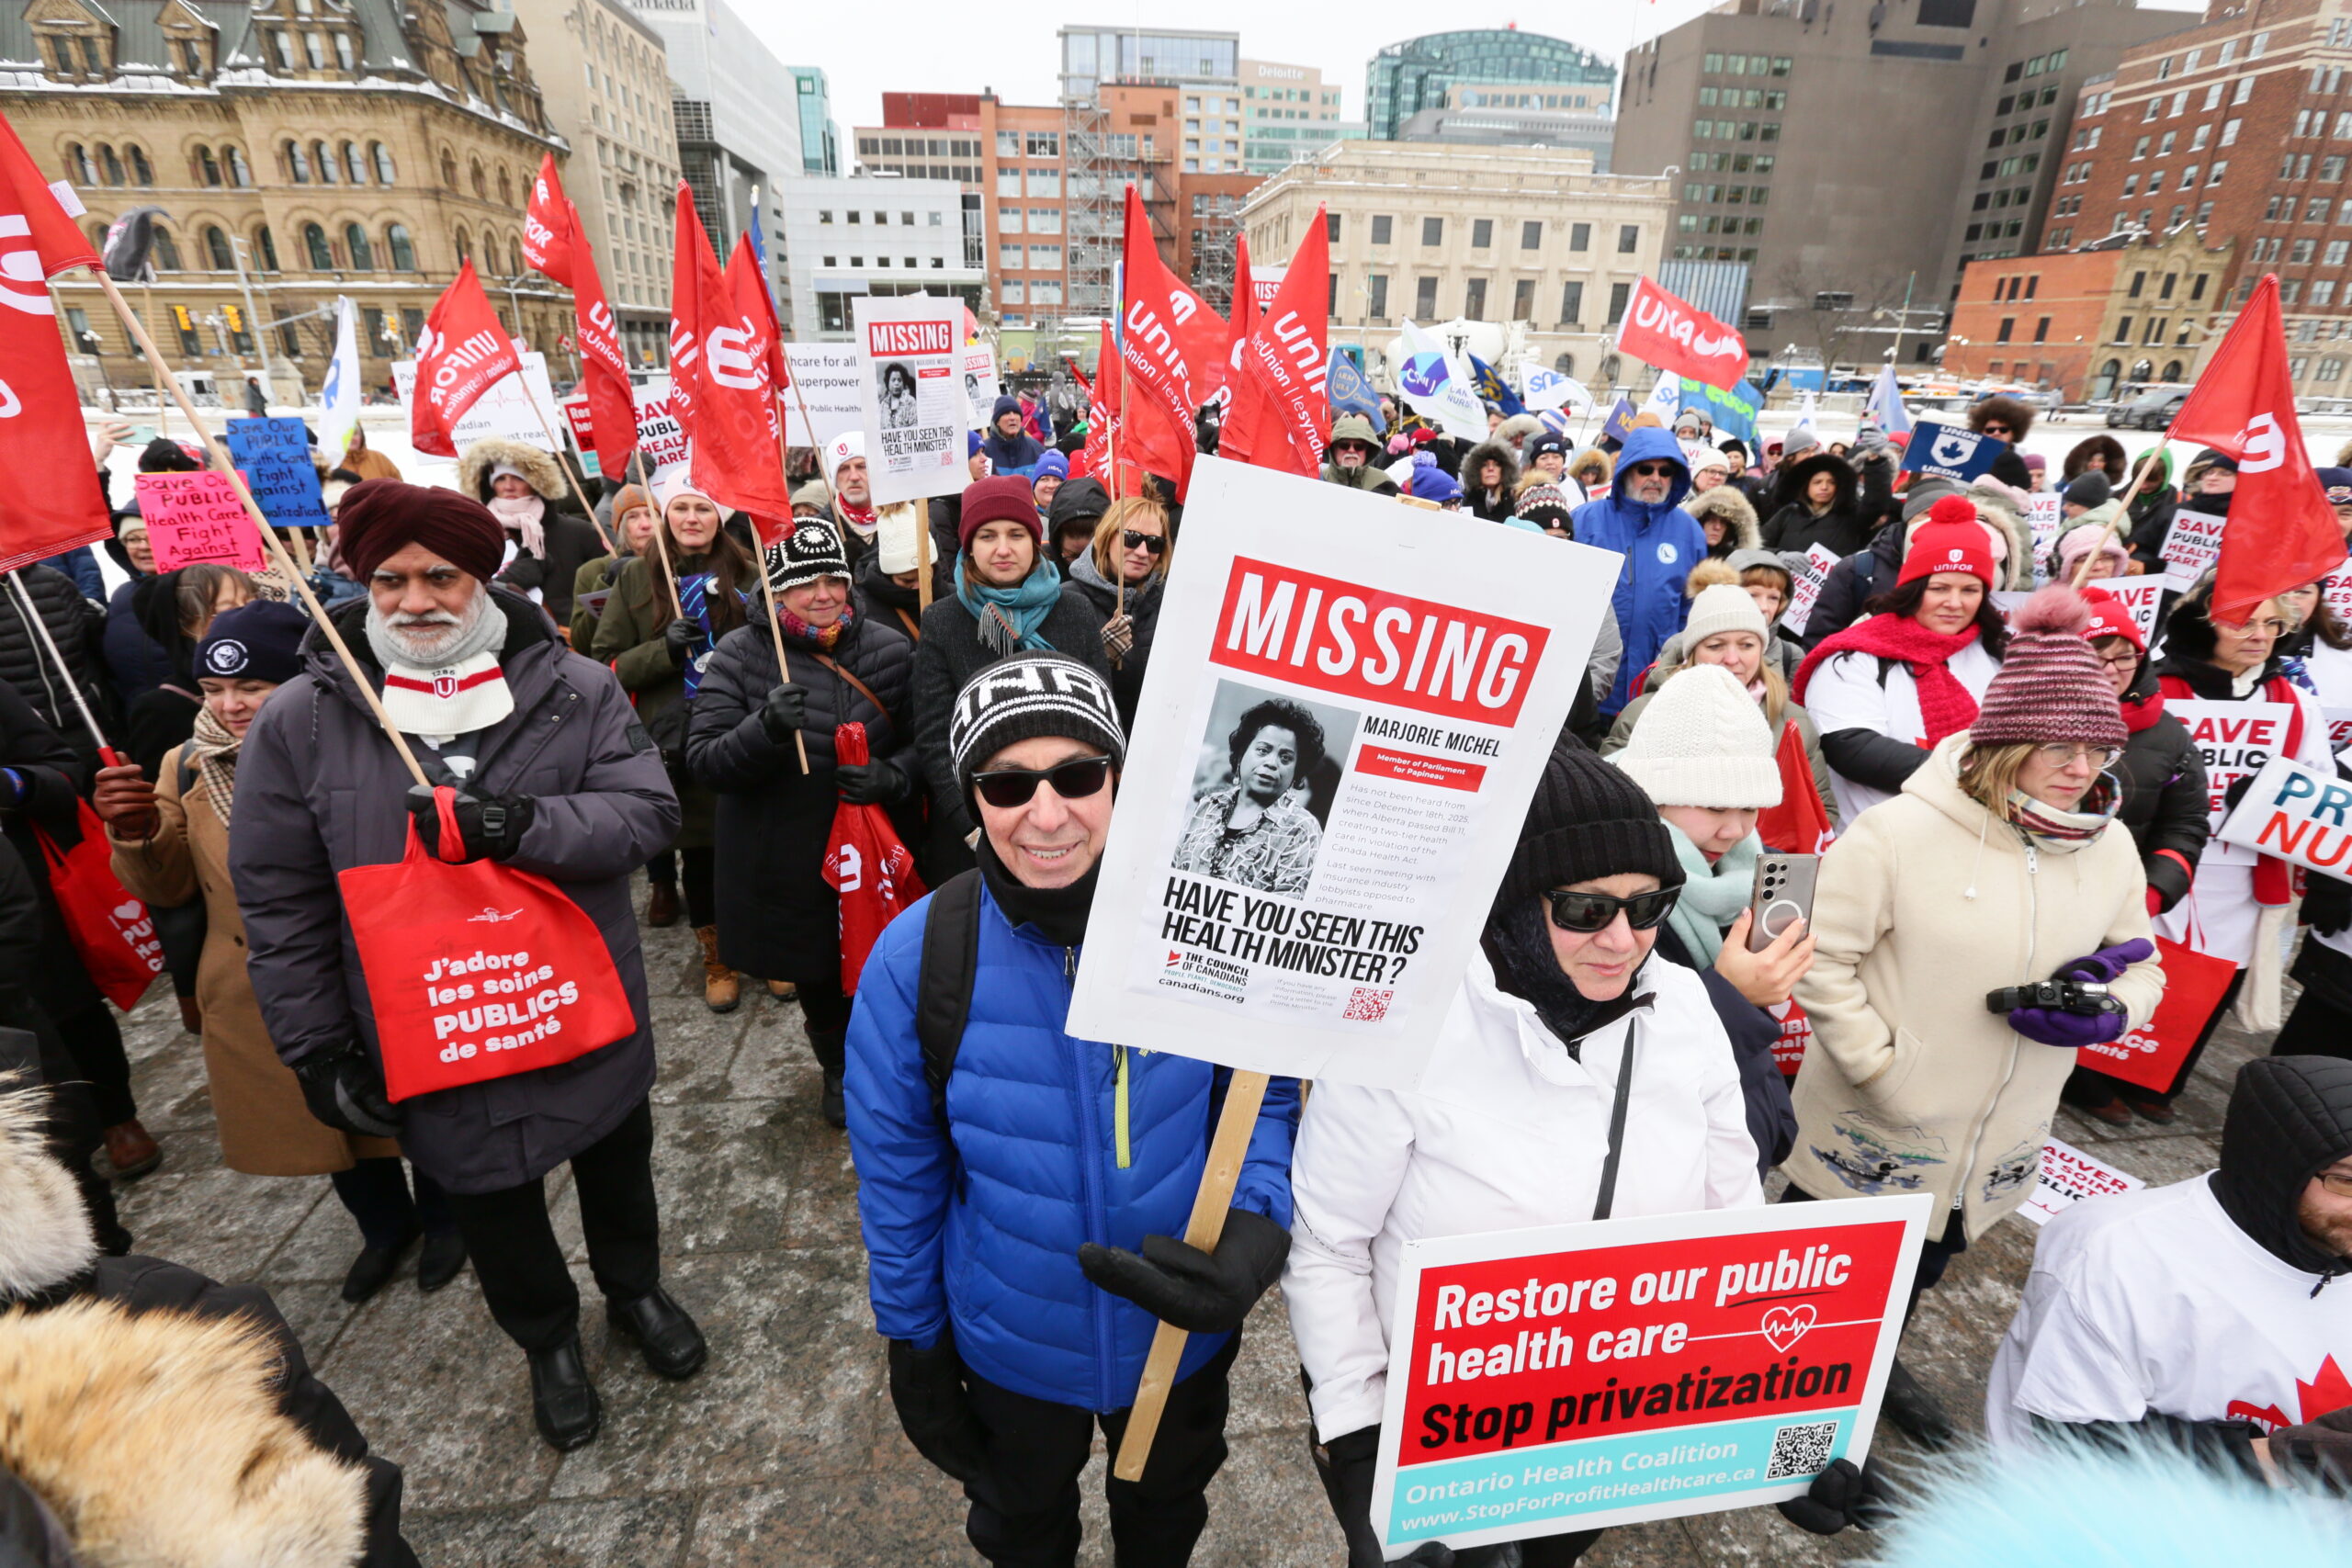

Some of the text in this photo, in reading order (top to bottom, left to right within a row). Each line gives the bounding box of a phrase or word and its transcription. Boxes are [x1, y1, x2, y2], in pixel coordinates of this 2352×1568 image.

[1259, 65, 1304, 80] Deloitte
[872, 323, 950, 353] MISSING
[825, 355, 840, 367] for
[842, 355, 856, 367] all
[634, 398, 672, 423] SAV
[268, 419, 297, 434] Our
[637, 421, 680, 440] PUBL
[882, 426, 954, 445] HAVE YOU SEEN THIS
[1939, 425, 1984, 443] UNDE
[246, 434, 300, 450] PUBLIC
[884, 442, 912, 457] HEALTH
[914, 439, 946, 453] MINISTER
[657, 450, 689, 467] ARE
[136, 474, 195, 491] Save
[257, 467, 295, 486] Fight
[1921, 464, 1963, 479] UEDN
[162, 491, 237, 508] PUBLIC
[251, 479, 307, 502] gainst
[146, 502, 249, 527] Health Care!
[177, 522, 233, 545] Fight
[2177, 518, 2223, 536] SAV
[169, 540, 239, 559] Against
[2163, 552, 2200, 568] CARE
[1226, 570, 1530, 712] MISSING
[1363, 716, 1501, 758] MARJORIE MICHEL
[1376, 753, 1466, 776] Member of Parliament
[2203, 748, 2269, 769] BLIC
[1393, 765, 1444, 782] for Papineau
[1346, 795, 1372, 807] since
[1374, 801, 1423, 818] December
[1351, 784, 1466, 810] Has not been heard from
[1338, 819, 1448, 845] creating two-tier health
[1342, 807, 1369, 818] when
[1371, 812, 1406, 827] Alberta
[1408, 820, 1440, 834] passed
[1442, 825, 1456, 835] Bill
[1331, 843, 1419, 865] Canada Health Act.
[1335, 831, 1438, 857] care in violation of the
[1327, 859, 1437, 884] Last seen meeting with
[1319, 884, 1416, 905] lobbyists opposed to
[1323, 873, 1412, 894] insurance industry
[1163, 876, 1425, 955] HAVE YOU SEEN THIS
[1315, 896, 1374, 912] pharmacare.
[1161, 911, 1265, 963] HEALTH
[1265, 937, 1390, 984] MINISTER
[1182, 962, 1248, 987] OF CANADIANS
[1185, 952, 1250, 977] THE COUNCIL
[427, 964, 554, 1007] les soins
[1159, 978, 1245, 1004] canadians.org
[1315, 985, 1327, 993] any
[434, 980, 579, 1040] PUBLICS
[1295, 997, 1313, 1007] letter
[439, 1014, 561, 1064] de santé
[1770, 1035, 1810, 1049] ealt
[2042, 1145, 2129, 1192] AUVER
[2042, 1167, 2098, 1196] SANT
[1433, 1244, 1852, 1331] Restore our public
[1427, 1321, 1689, 1386] health care
[1419, 1356, 1852, 1449] Stop privatization
[1406, 1439, 1738, 1505] Ontario Health Coalition
[1401, 1467, 1756, 1530] www.StopForProfitHealthcare.ca
